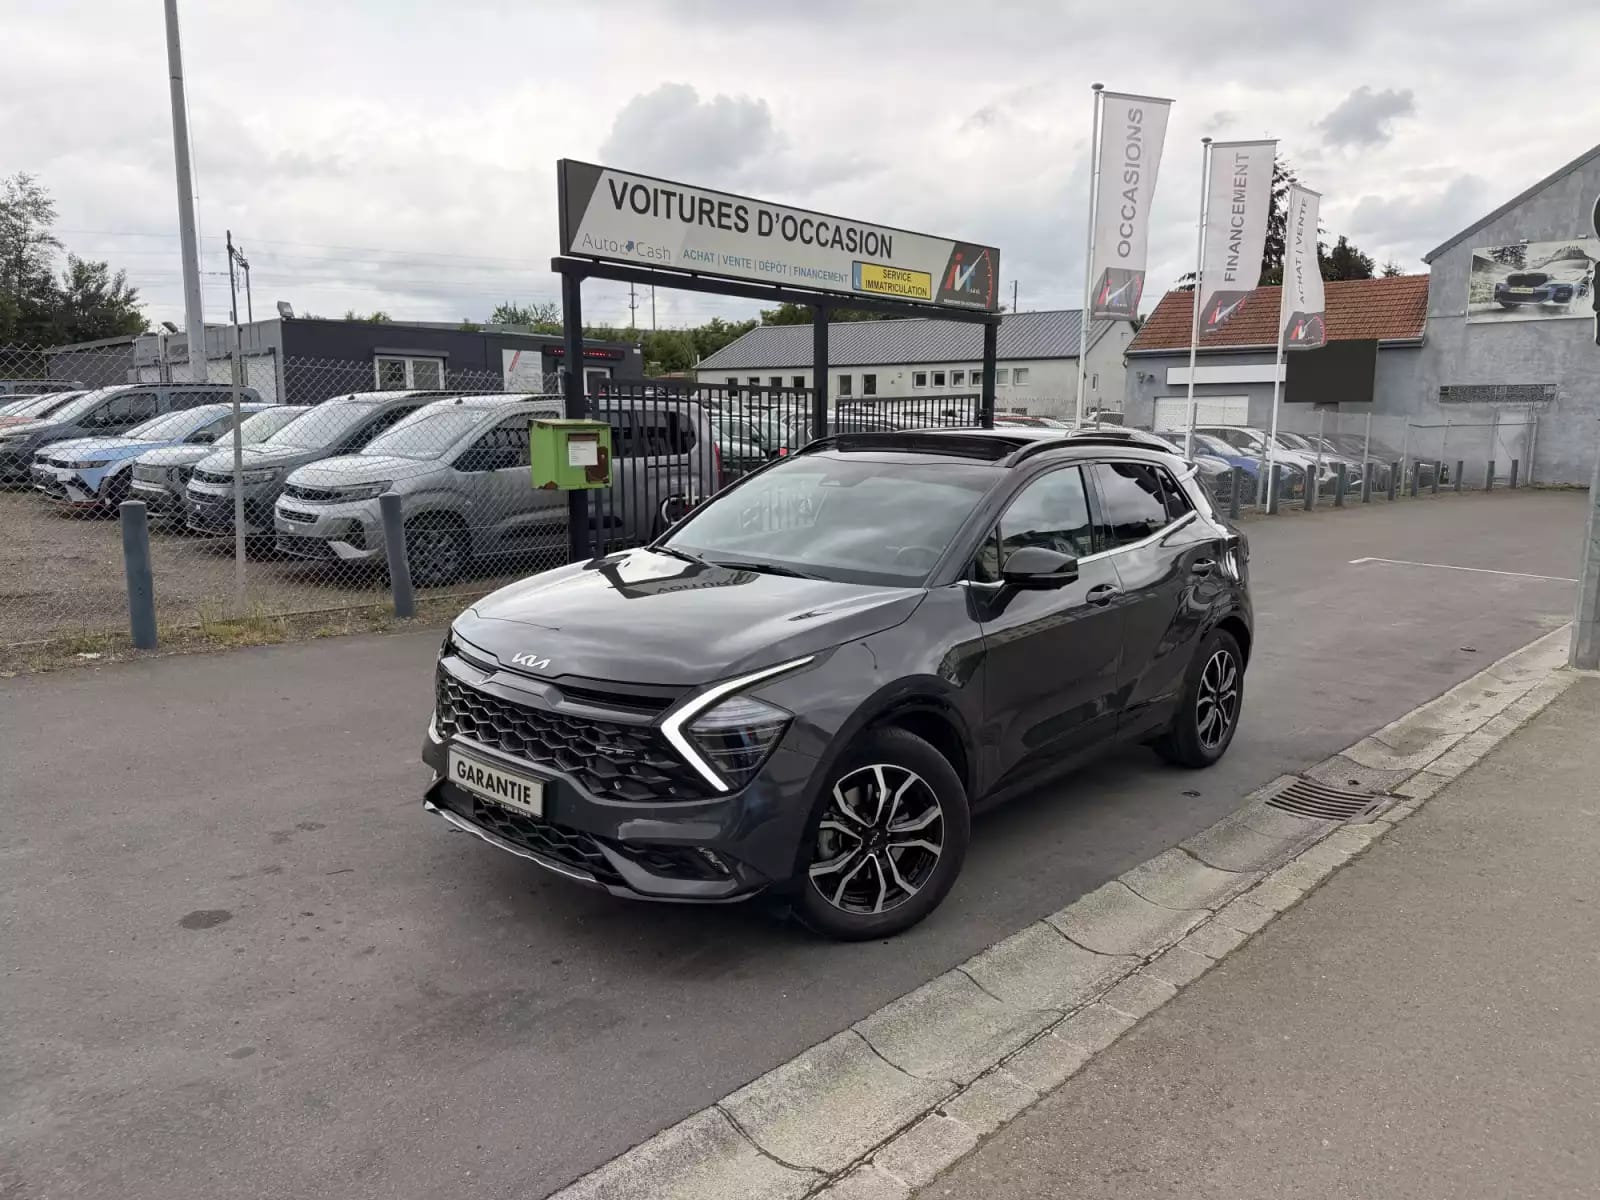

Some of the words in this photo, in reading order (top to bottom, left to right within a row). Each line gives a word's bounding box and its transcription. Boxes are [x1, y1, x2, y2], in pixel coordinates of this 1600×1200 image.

[1117, 107, 1144, 258] OCCASIONS
[608, 178, 749, 233] VOITURES
[758, 209, 893, 259] D'OCCASION
[1224, 152, 1249, 282] FINANCEMENT
[582, 232, 618, 252] Auto
[636, 241, 671, 260] Cash
[683, 249, 715, 263] ACHAT
[722, 255, 752, 269] VENTE
[758, 260, 787, 275] DÉPÔT
[793, 266, 848, 283] FINANCEMENT
[882, 268, 912, 283] SERVICE
[865, 279, 928, 297] IMMATRICULATION
[456, 760, 532, 805] GARANTIE
